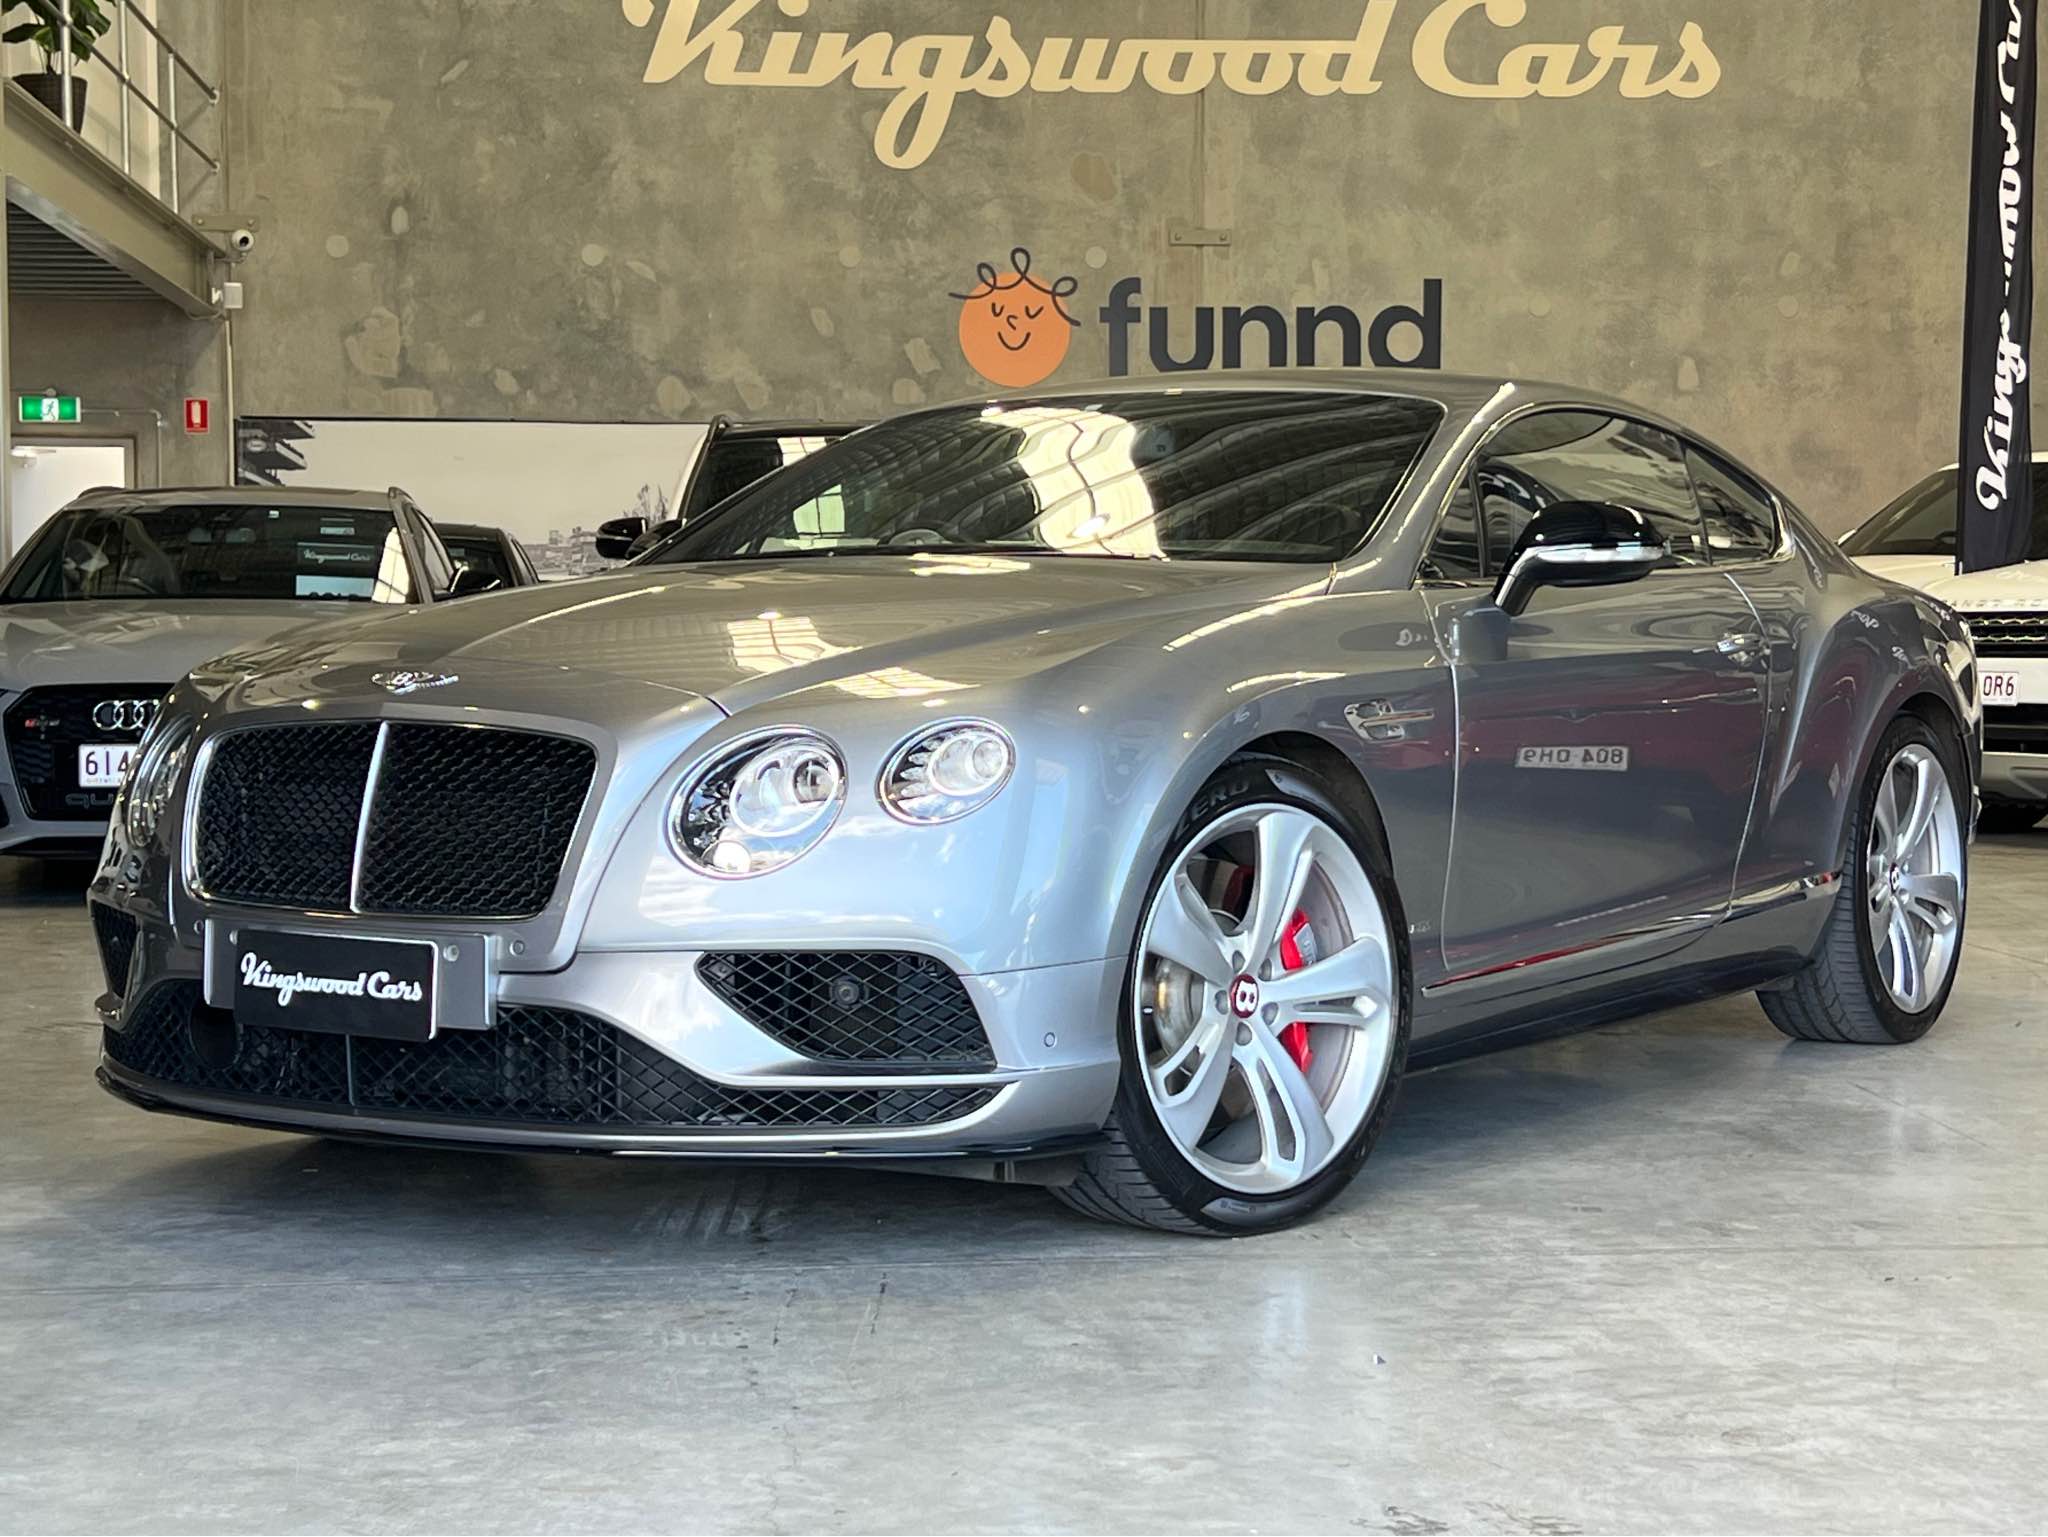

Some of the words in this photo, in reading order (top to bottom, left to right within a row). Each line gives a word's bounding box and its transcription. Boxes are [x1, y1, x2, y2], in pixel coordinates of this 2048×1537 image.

[622, 0, 1397, 168] Kingswood
[1411, 0, 1721, 99] Cars
[1099, 277, 1442, 377] funnd
[240, 952, 367, 1006] Kingswood
[366, 971, 422, 1001] Cars
